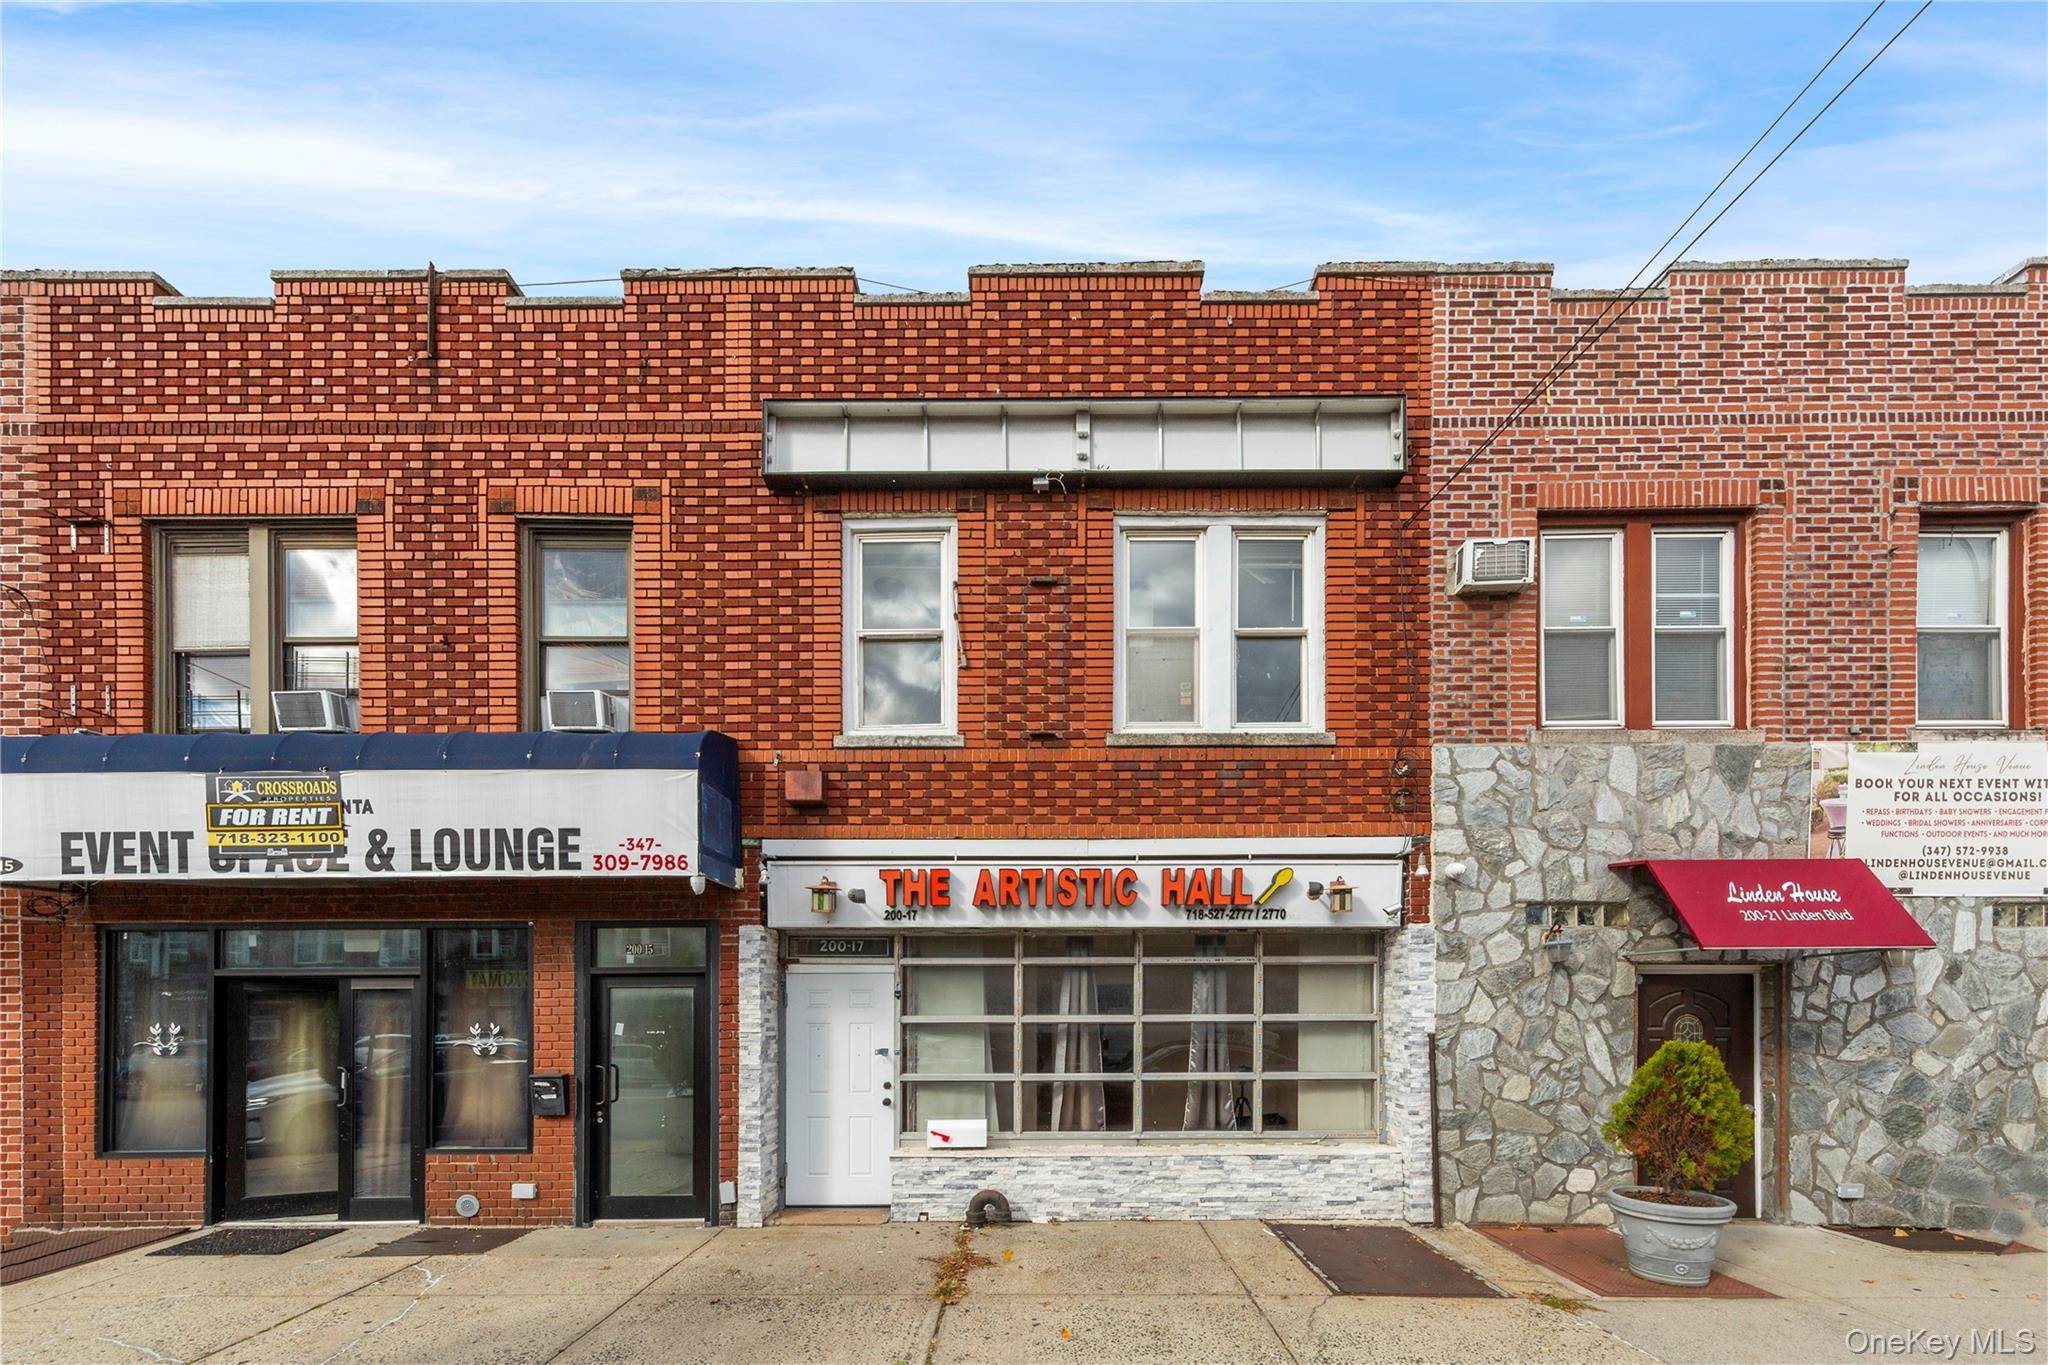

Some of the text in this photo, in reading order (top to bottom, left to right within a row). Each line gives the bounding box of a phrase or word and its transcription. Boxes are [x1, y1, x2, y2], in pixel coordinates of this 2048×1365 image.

[1903, 754, 1946, 775] Linden
[256, 780, 338, 796] CROSSROADS
[1855, 778, 1894, 789] BOOK
[1898, 778, 1935, 789] YOUR
[1939, 778, 1973, 789] NEXT
[1977, 778, 2020, 789] EVENT
[1894, 791, 2043, 802] FOR ALL OCCASIONS!
[218, 807, 333, 827] FOR RENT
[1865, 808, 1891, 816] REPASS
[1895, 808, 1933, 816] BIRTHDAYS
[1939, 808, 1957, 816] BABY
[1959, 808, 1992, 816] SHOWERS
[1998, 808, 2043, 816] ENGAGEMENT
[1865, 819, 1902, 827] WEDDINGS
[1908, 819, 1932, 827] BRIDAL
[1933, 819, 1966, 827] SHOWERS
[1970, 819, 2022, 827] ANNIVERSARIES
[215, 832, 341, 844] 718-323-1100
[1881, 830, 1919, 838] FUNCTIONS
[1925, 830, 1962, 838] OUTDOOR
[1963, 830, 1988, 838] EVENTS
[1993, 830, 2008, 838] AND
[2009, 830, 2029, 838] MUCH
[60, 831, 195, 875] EVENT
[364, 828, 396, 872] &
[410, 827, 582, 872] LOUNGE
[1922, 845, 2009, 857] (347) 572-9938
[592, 854, 689, 871] 309-7986
[1899, 871, 2031, 881] @LINDENHOUSEVENUE
[878, 867, 1253, 908] THE ARTISTIC HALL
[1727, 881, 1842, 903] Linden House
[883, 909, 918, 922] 200-17
[1185, 908, 1254, 921] 718-527-2777
[1261, 908, 1287, 920] 2770
[1739, 908, 1855, 921] 200-21 Linden Blvd
[819, 940, 865, 953] 200-17
